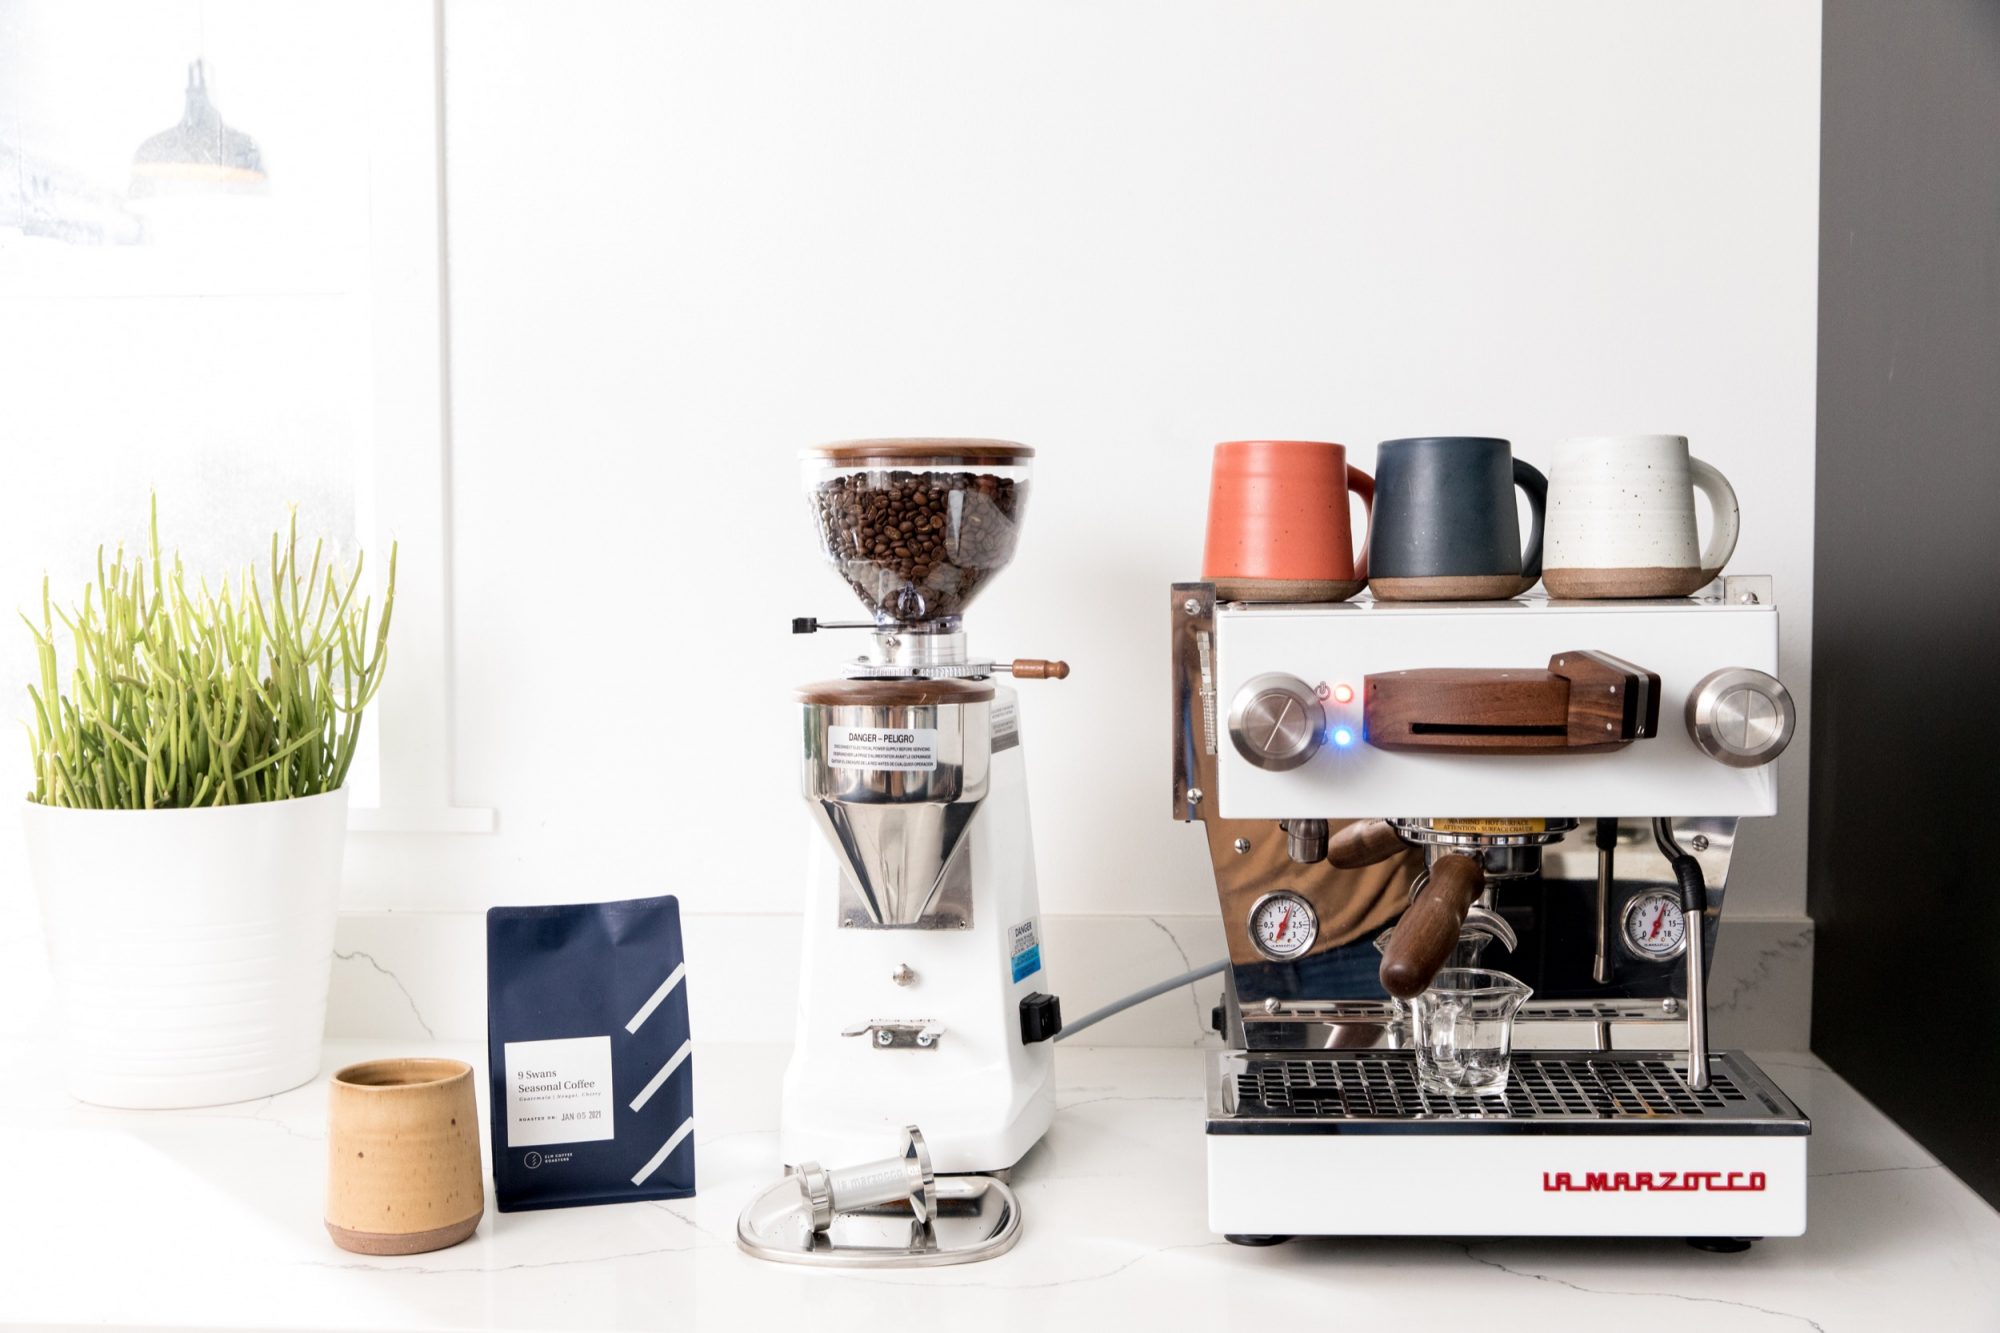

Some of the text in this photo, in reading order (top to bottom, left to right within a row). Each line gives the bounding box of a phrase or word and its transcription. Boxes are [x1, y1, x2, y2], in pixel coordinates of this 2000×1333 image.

[848, 732, 877, 742] DANGER
[884, 734, 914, 743] PELIGRO
[1015, 921, 1032, 937] DANGER
[518, 1070, 557, 1080] 9 Swans
[518, 1080, 595, 1093] Seasonal Coffee
[561, 1112, 575, 1121] JAN
[589, 1110, 602, 1119] 2021
[1543, 1172, 1766, 1191] LA MARZOCCO
